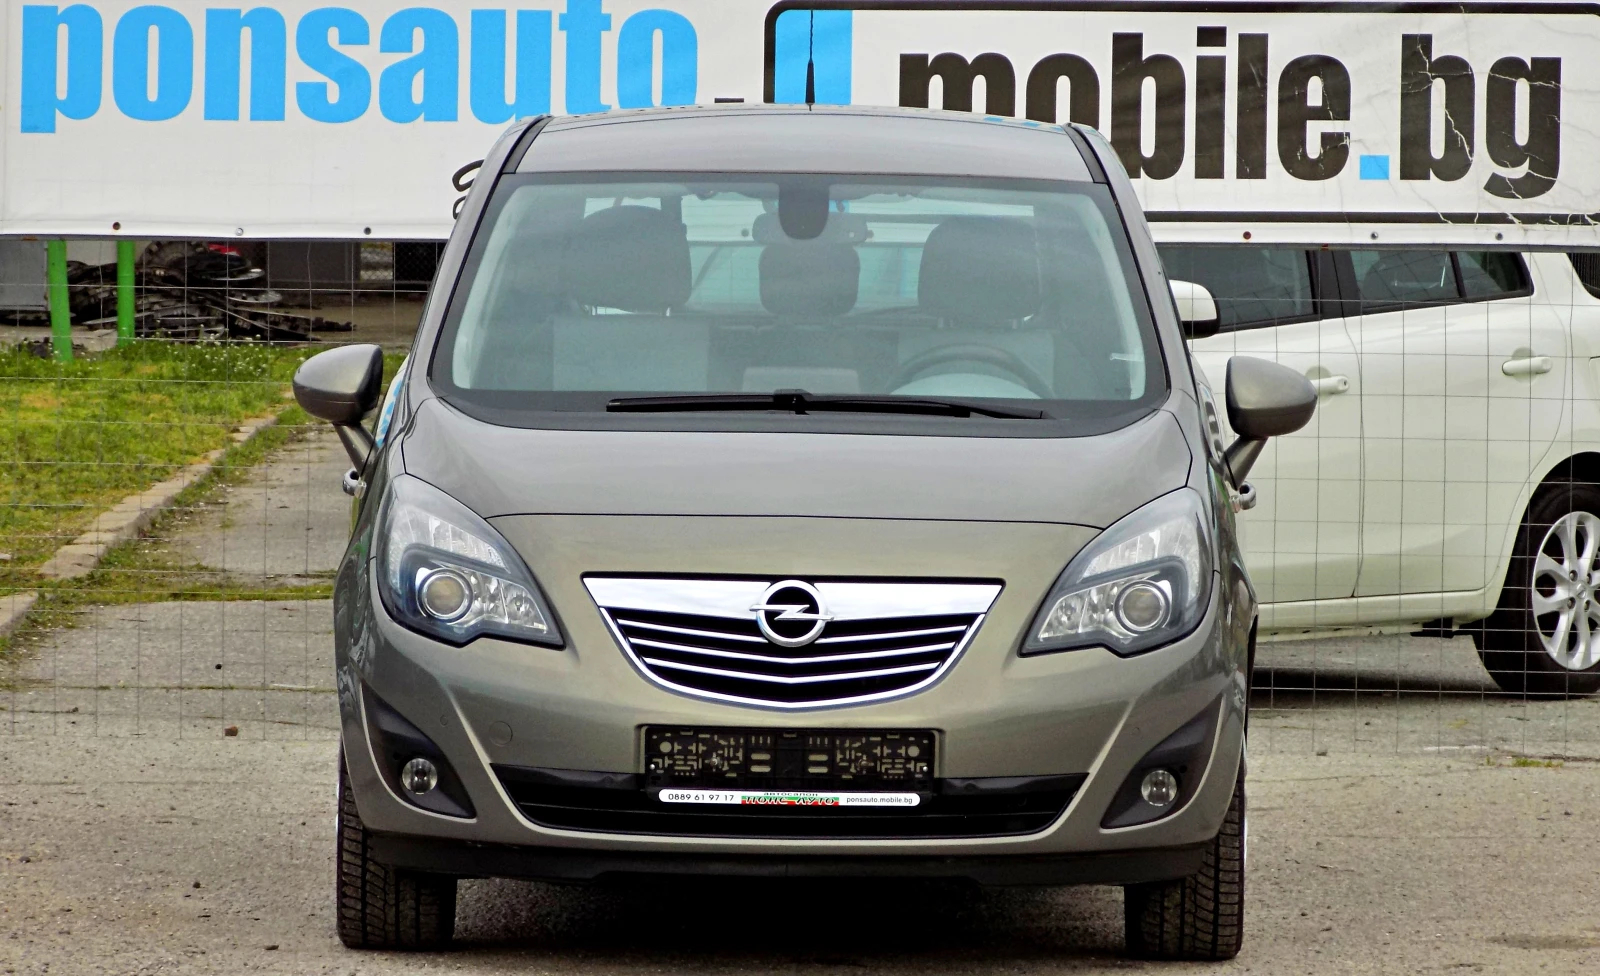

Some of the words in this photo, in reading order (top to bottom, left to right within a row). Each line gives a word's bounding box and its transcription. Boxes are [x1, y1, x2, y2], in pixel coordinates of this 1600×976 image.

[20, 0, 698, 134] ponsauto
[668, 793, 691, 801] 0889
[708, 794, 720, 802] 97
[724, 794, 734, 802] 17
[846, 796, 913, 804] ponsauto.mobile.bg
